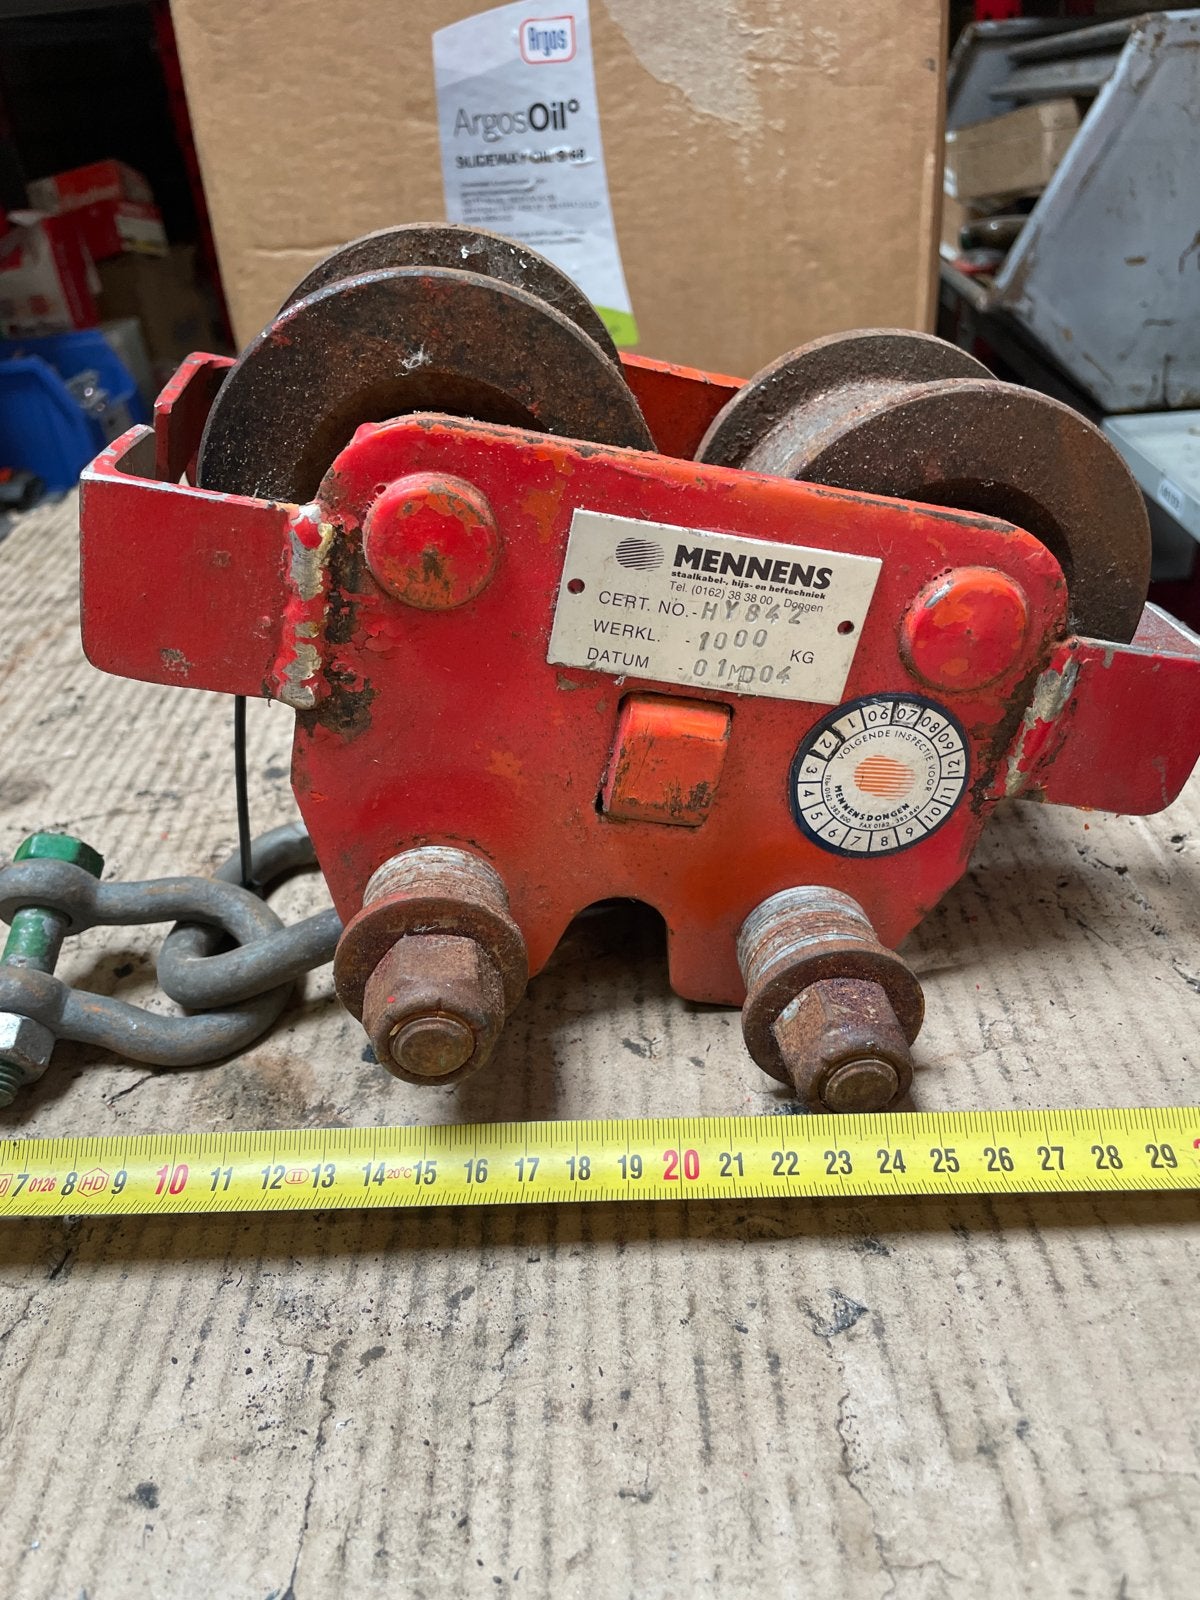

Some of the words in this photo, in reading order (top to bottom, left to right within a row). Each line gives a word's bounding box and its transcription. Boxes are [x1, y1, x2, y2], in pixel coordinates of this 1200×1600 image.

[527, 27, 568, 56] Argos
[673, 544, 833, 590] MENNENS
[598, 591, 650, 612] CERT.
[670, 581, 688, 593] Tel.
[691, 584, 725, 600] (0162)
[728, 590, 741, 600] 38
[744, 593, 757, 603] 38
[760, 595, 773, 605] 00
[593, 618, 661, 643] WERKL.
[790, 650, 815, 665] KG
[587, 647, 650, 668] DATUM
[896, 708, 918, 721] 07
[921, 716, 941, 733] 08
[819, 739, 832, 749] 2
[837, 730, 891, 761] VOLGENDE
[894, 730, 934, 762] INSPECTIE
[925, 763, 936, 792] VOOR
[947, 759, 960, 776] 12
[806, 766, 818, 774] 3
[803, 789, 815, 797] 4
[810, 812, 823, 820] 5
[924, 807, 942, 823] 10
[850, 836, 861, 847] 7
[880, 836, 889, 847] 8
[12, 1173, 30, 1197] 7
[28, 1176, 57, 1192] 0126
[60, 1171, 78, 1196] 8
[81, 1175, 105, 1191] HD
[111, 1170, 128, 1195] 9
[155, 1163, 190, 1195] 10
[210, 1166, 234, 1192] 11
[260, 1164, 287, 1190] 12
[311, 1163, 337, 1189] 13
[362, 1162, 386, 1186] 14
[412, 1160, 437, 1185] 15
[463, 1158, 489, 1184] 16
[514, 1157, 540, 1182] 17
[566, 1155, 591, 1181] 18
[617, 1154, 643, 1179] 19
[663, 1149, 700, 1181] 20
[718, 1152, 744, 1177] 21
[771, 1151, 800, 1176] 22
[824, 1150, 853, 1175] 23
[876, 1149, 907, 1174] 24
[929, 1148, 960, 1173] 25
[983, 1147, 1014, 1172] 26
[1036, 1146, 1065, 1171] 27
[1091, 1145, 1124, 1170] 28
[1145, 1144, 1178, 1169] 29
